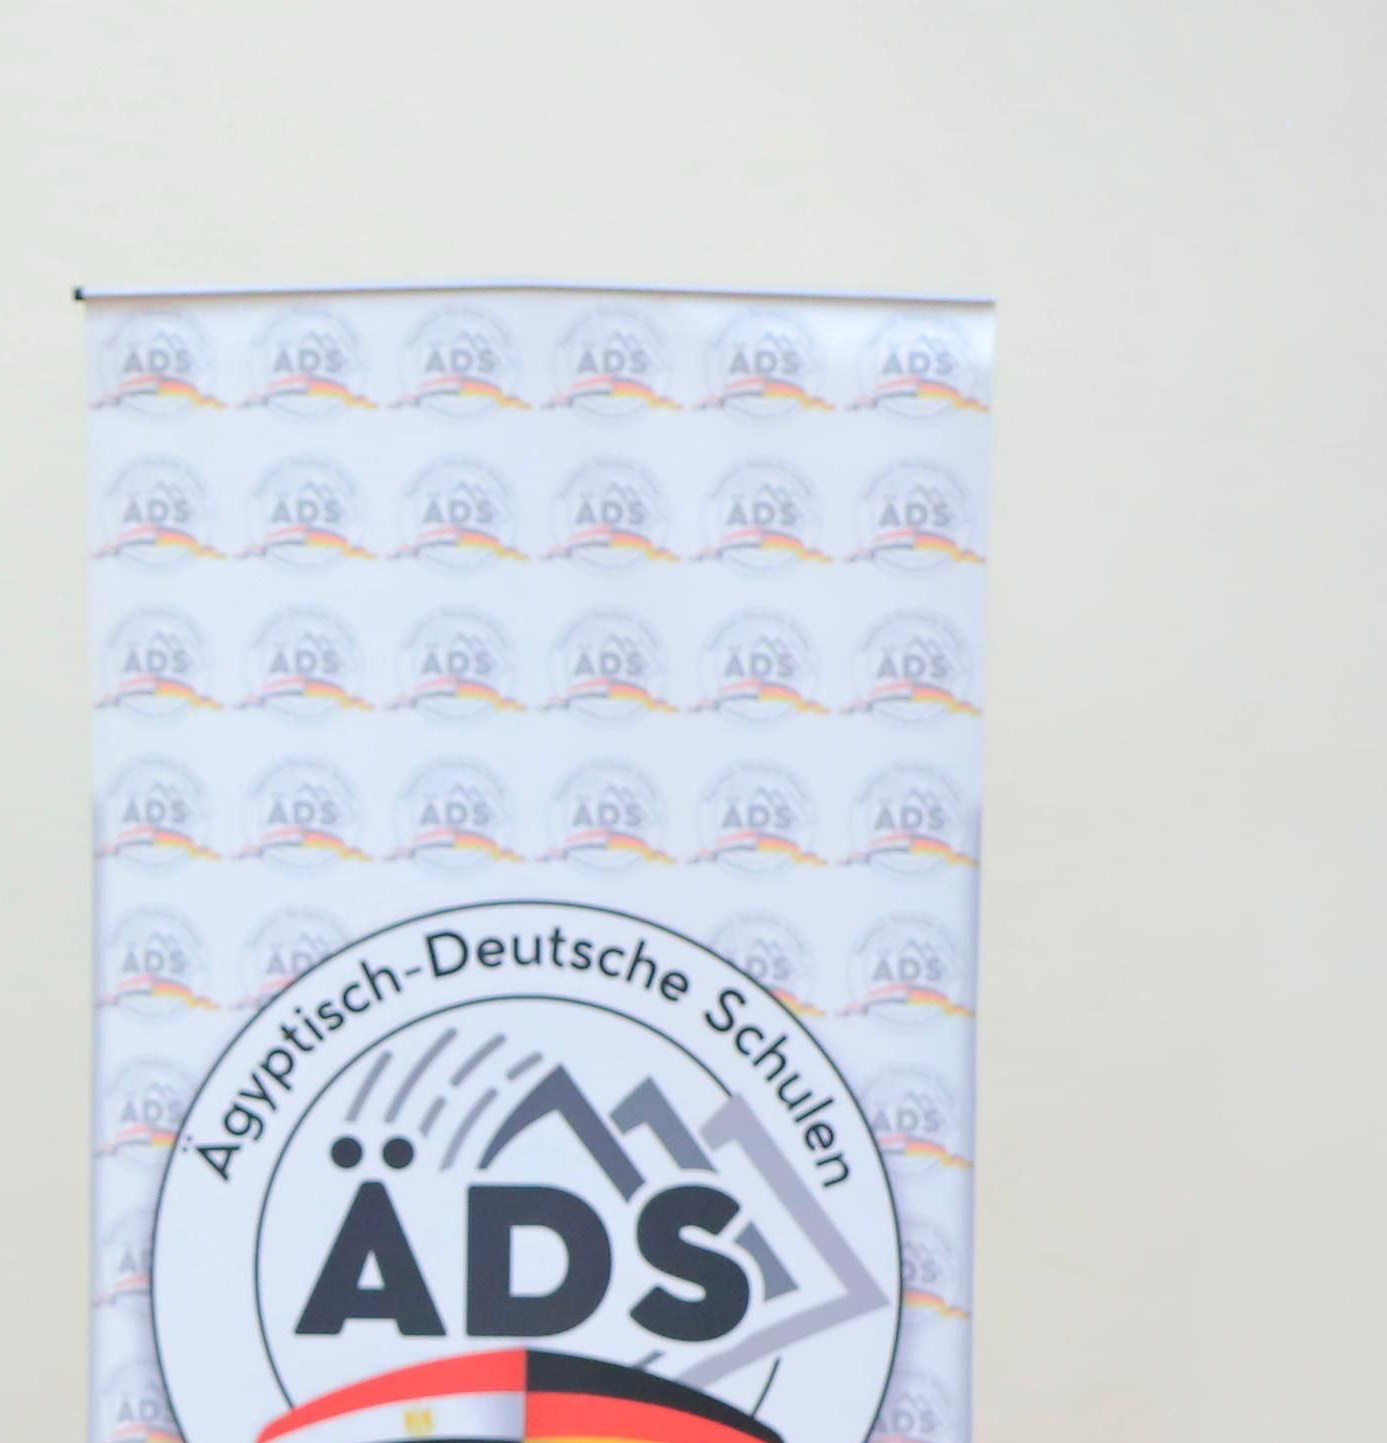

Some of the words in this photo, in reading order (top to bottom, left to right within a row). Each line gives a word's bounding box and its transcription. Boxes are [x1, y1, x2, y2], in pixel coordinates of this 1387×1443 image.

[181, 926, 690, 1181] Ägyptisch-Deutsche
[704, 989, 851, 1188] Schulen
[295, 1136, 750, 1342] ÄDS
